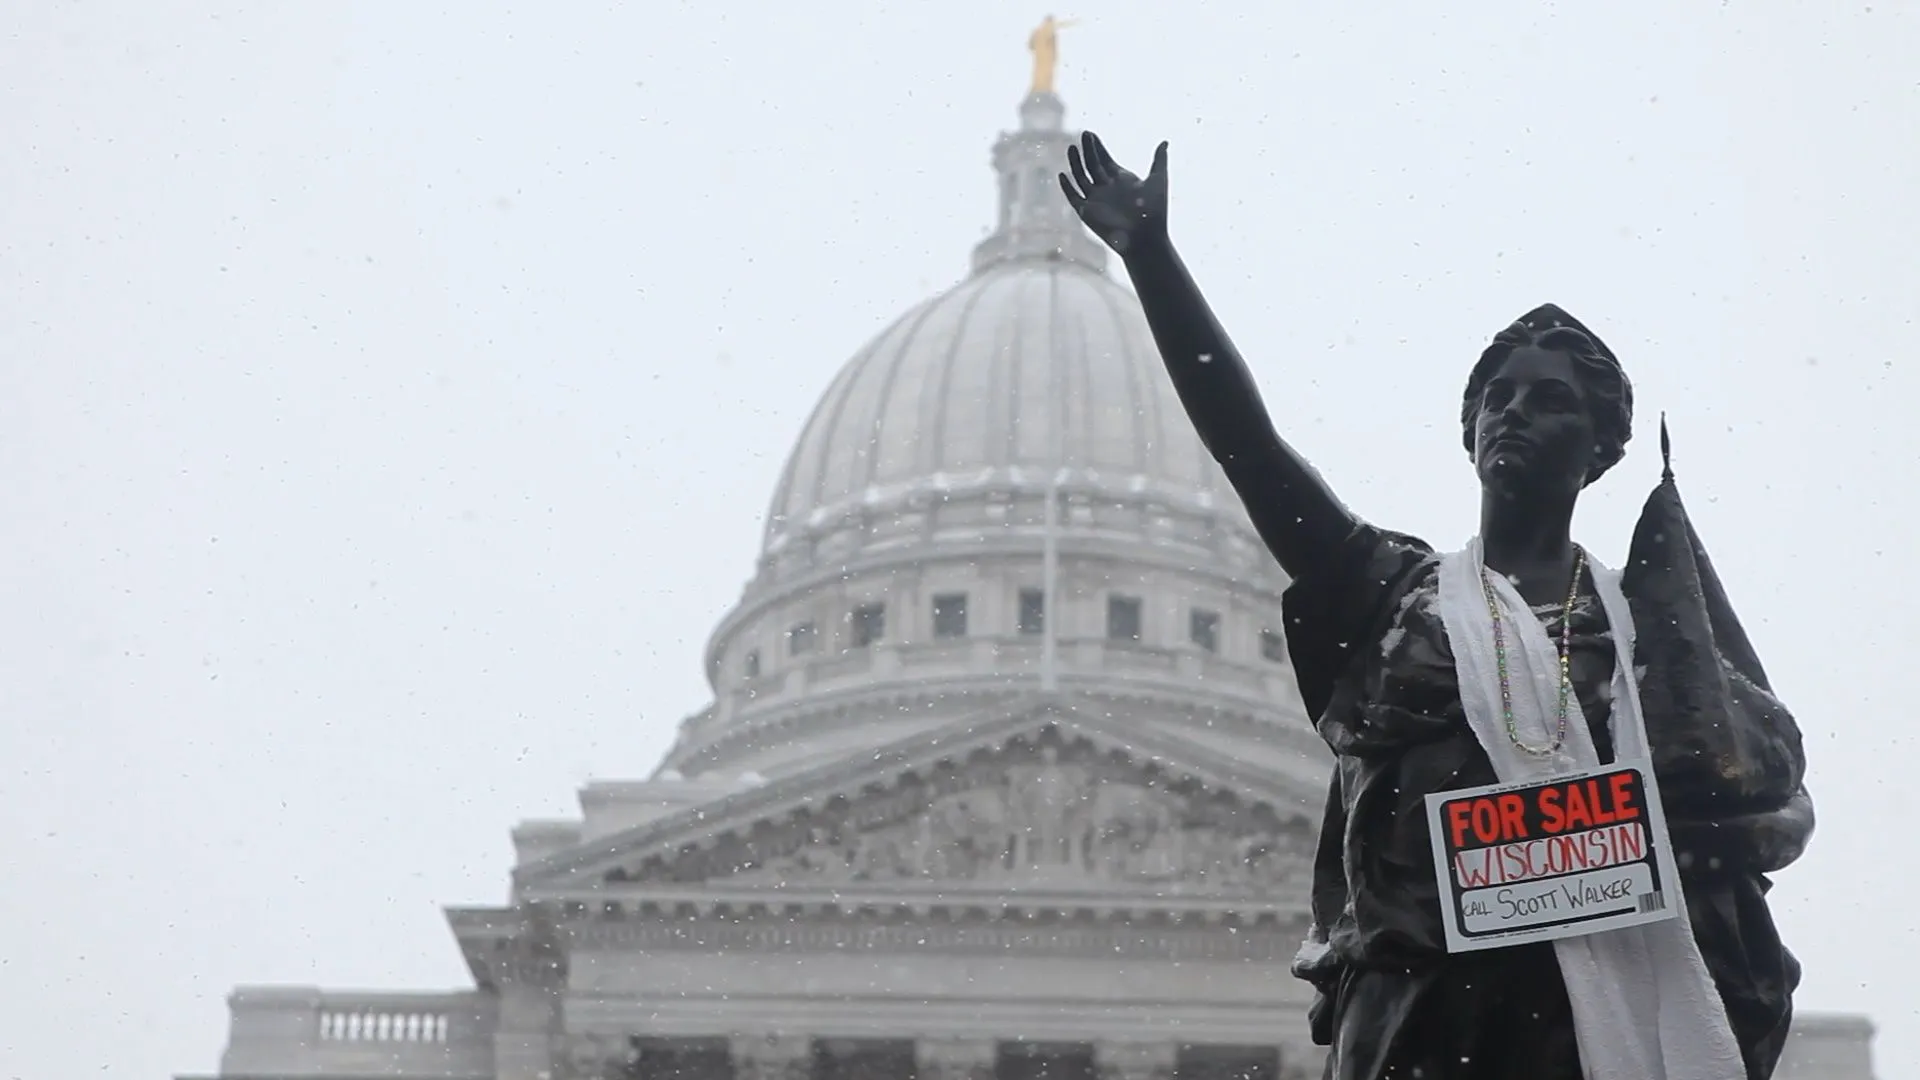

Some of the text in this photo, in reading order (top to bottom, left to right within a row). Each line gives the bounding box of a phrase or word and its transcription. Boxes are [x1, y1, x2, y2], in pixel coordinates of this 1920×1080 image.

[1448, 774, 1640, 847] FOR SALE
[1455, 823, 1641, 888] WISCONSIN
[1497, 888, 1558, 920] SCOTT
[1561, 878, 1633, 909] WALKER
